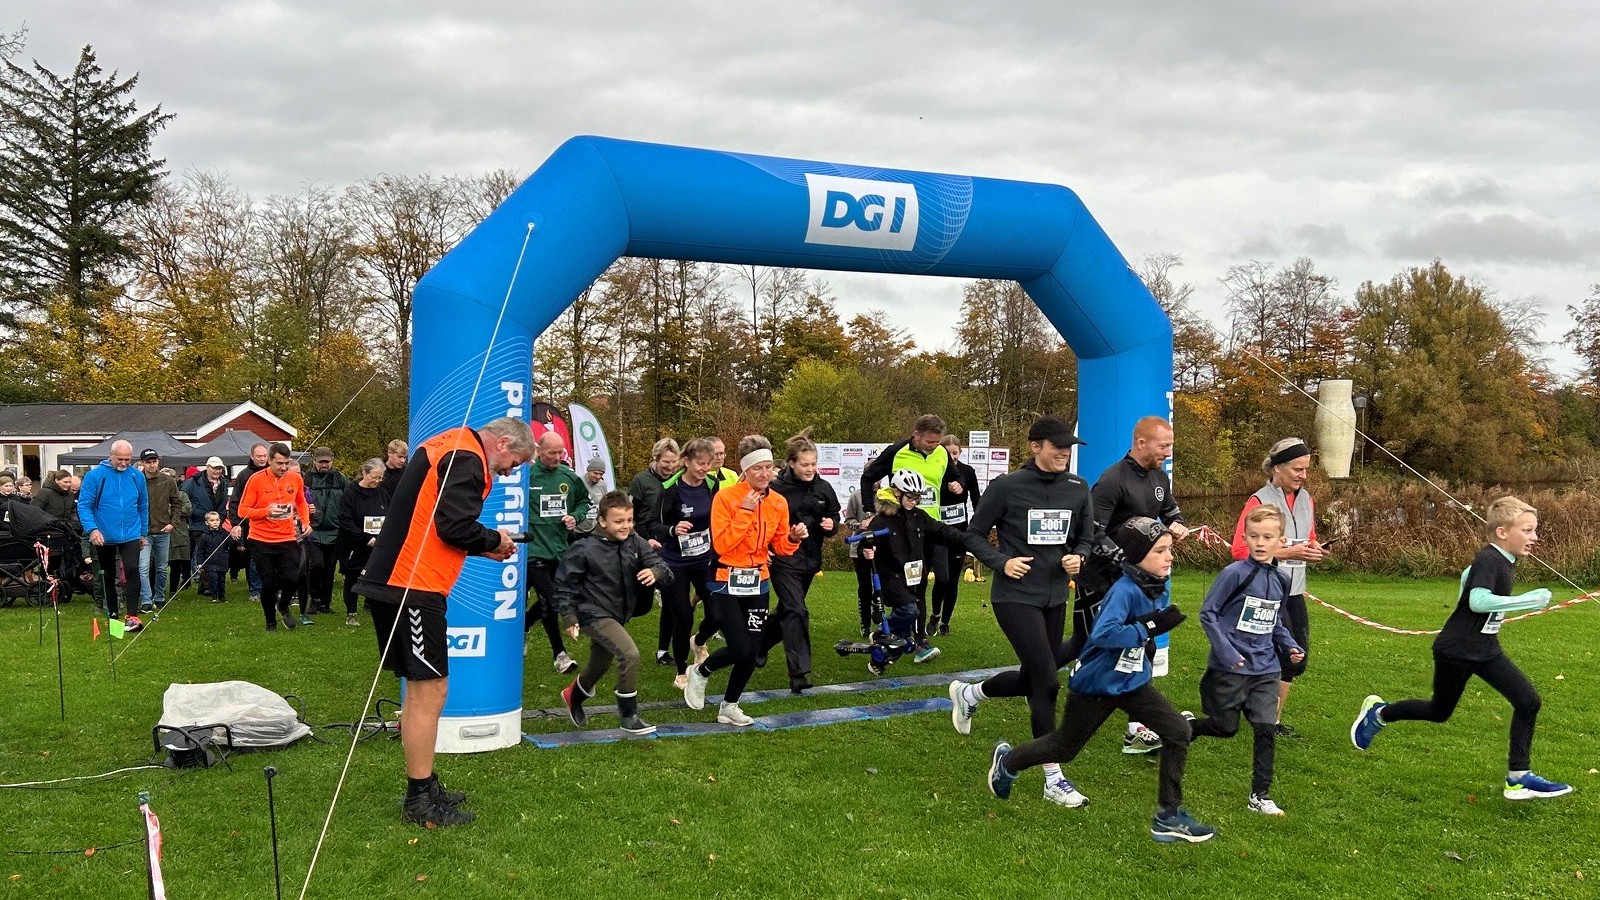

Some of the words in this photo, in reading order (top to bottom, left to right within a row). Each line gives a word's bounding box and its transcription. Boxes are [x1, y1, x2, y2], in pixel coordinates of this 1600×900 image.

[821, 190, 906, 233] DGI
[868, 449, 878, 457] JK
[494, 381, 524, 620] Nojyld
[1040, 520, 1063, 531] 5001
